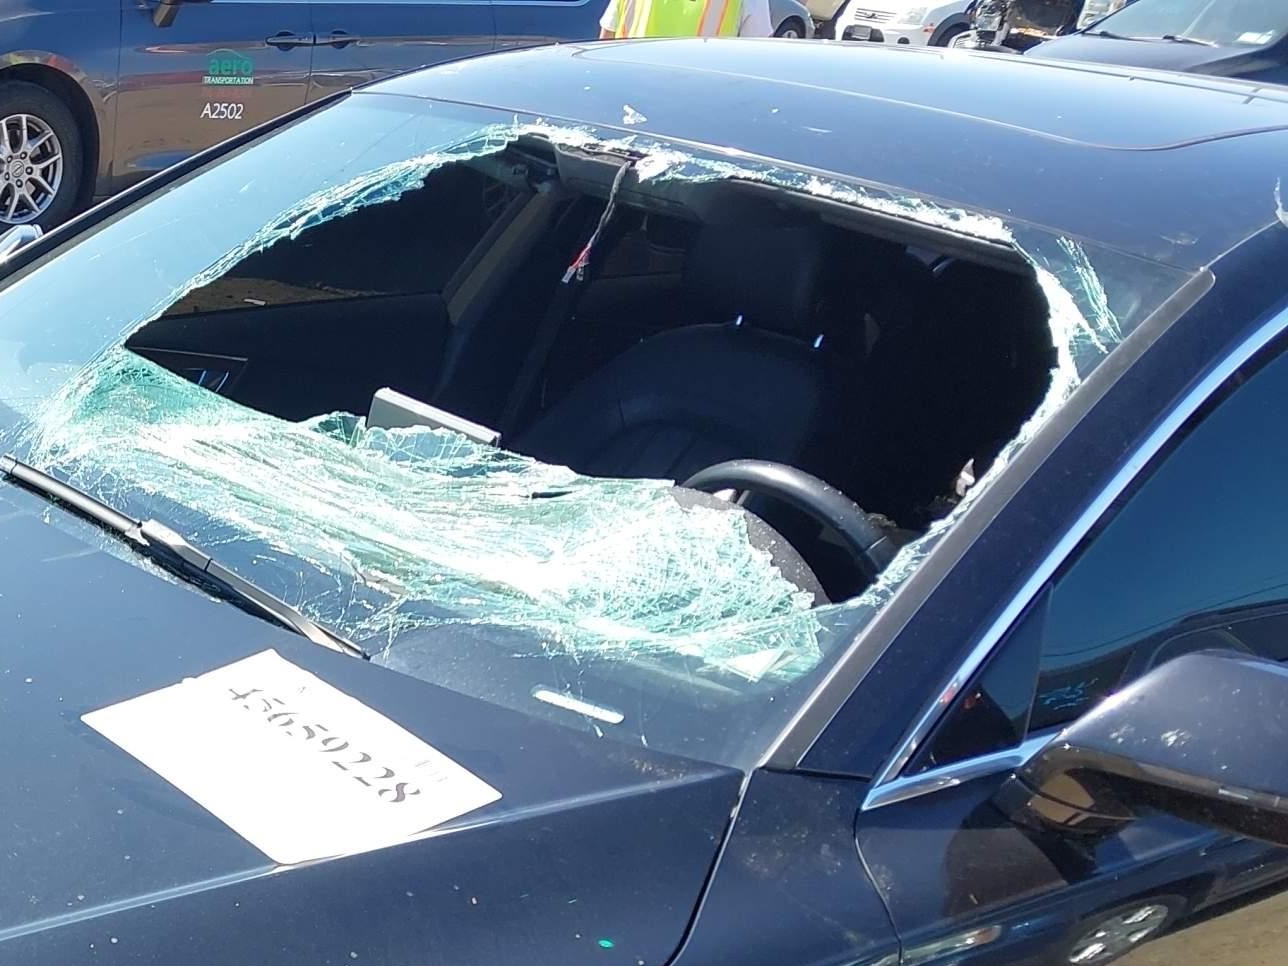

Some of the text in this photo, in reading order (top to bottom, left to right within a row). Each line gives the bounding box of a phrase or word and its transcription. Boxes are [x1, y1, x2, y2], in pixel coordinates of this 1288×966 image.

[208, 58, 253, 75] aero
[202, 76, 254, 85] TRANSPORTATION
[200, 102, 243, 119] A2502
[228, 687, 422, 803] 45659228
